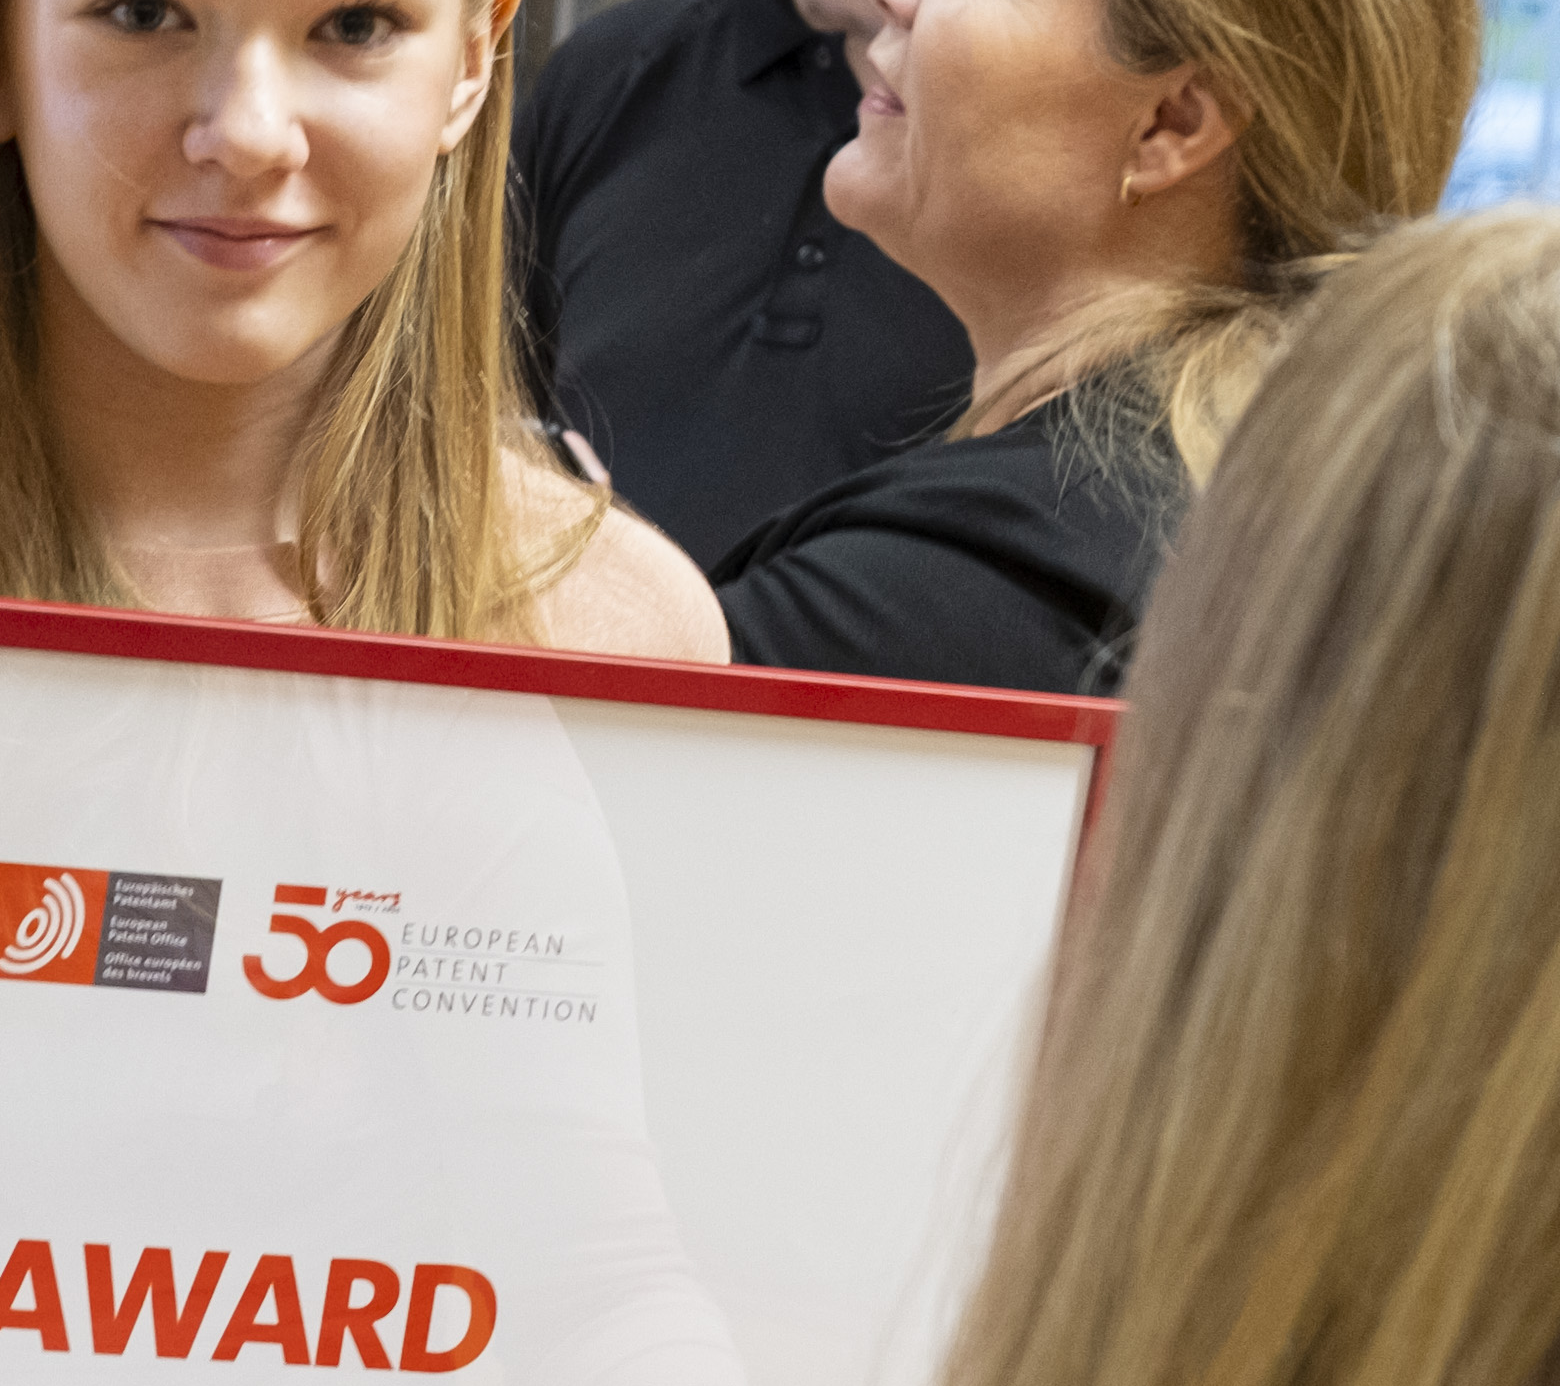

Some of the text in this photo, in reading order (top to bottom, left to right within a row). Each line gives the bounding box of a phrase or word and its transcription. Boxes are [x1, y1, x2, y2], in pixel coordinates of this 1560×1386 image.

[109, 914, 168, 932] European
[107, 928, 188, 947] Patent Office
[242, 883, 403, 1005] 50 years
[401, 922, 565, 956] EUROPEAN
[104, 951, 142, 967] Office
[395, 955, 509, 984] PATENT
[102, 965, 172, 983] des brevets
[391, 987, 598, 1023] CONVENTION
